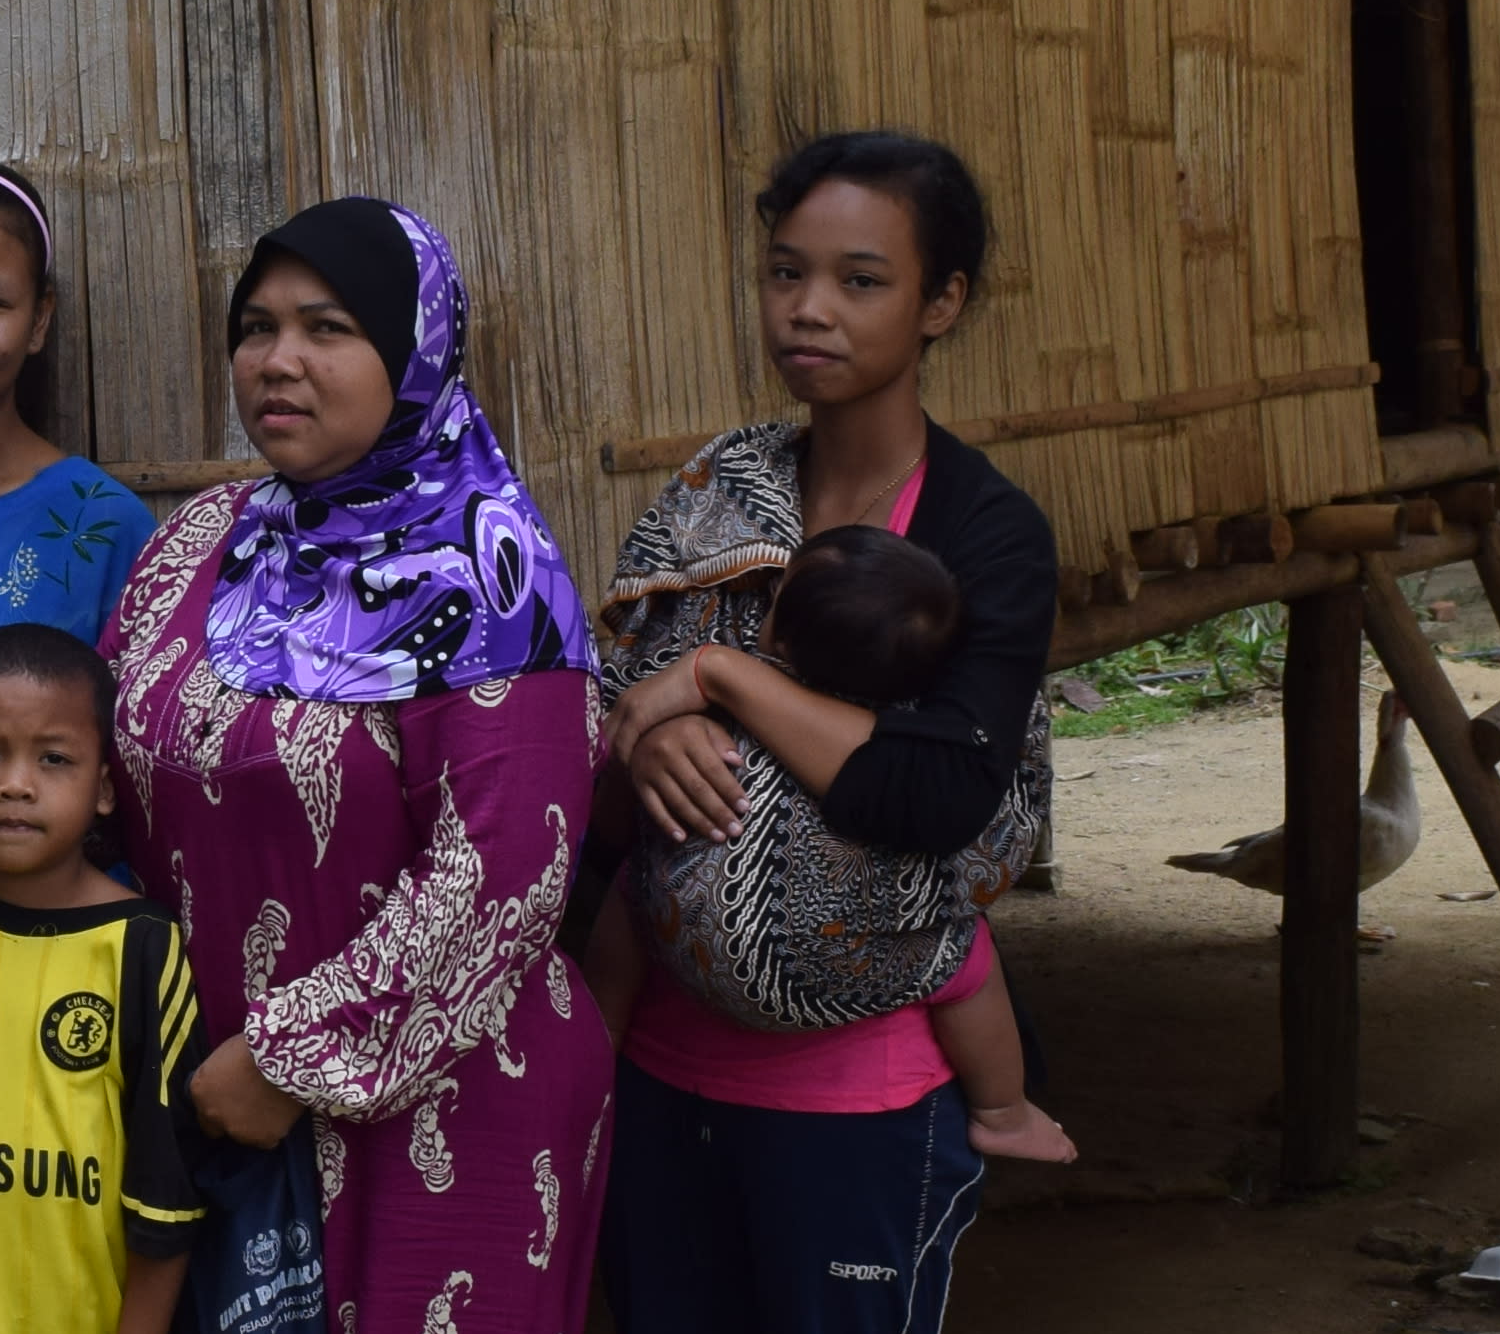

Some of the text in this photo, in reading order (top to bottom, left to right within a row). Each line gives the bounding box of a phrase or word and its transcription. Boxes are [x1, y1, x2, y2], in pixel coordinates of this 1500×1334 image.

[65, 995, 112, 1021] CHELSEA
[829, 1261, 898, 1281] SPORT
[219, 1291, 252, 1332] UNIT
